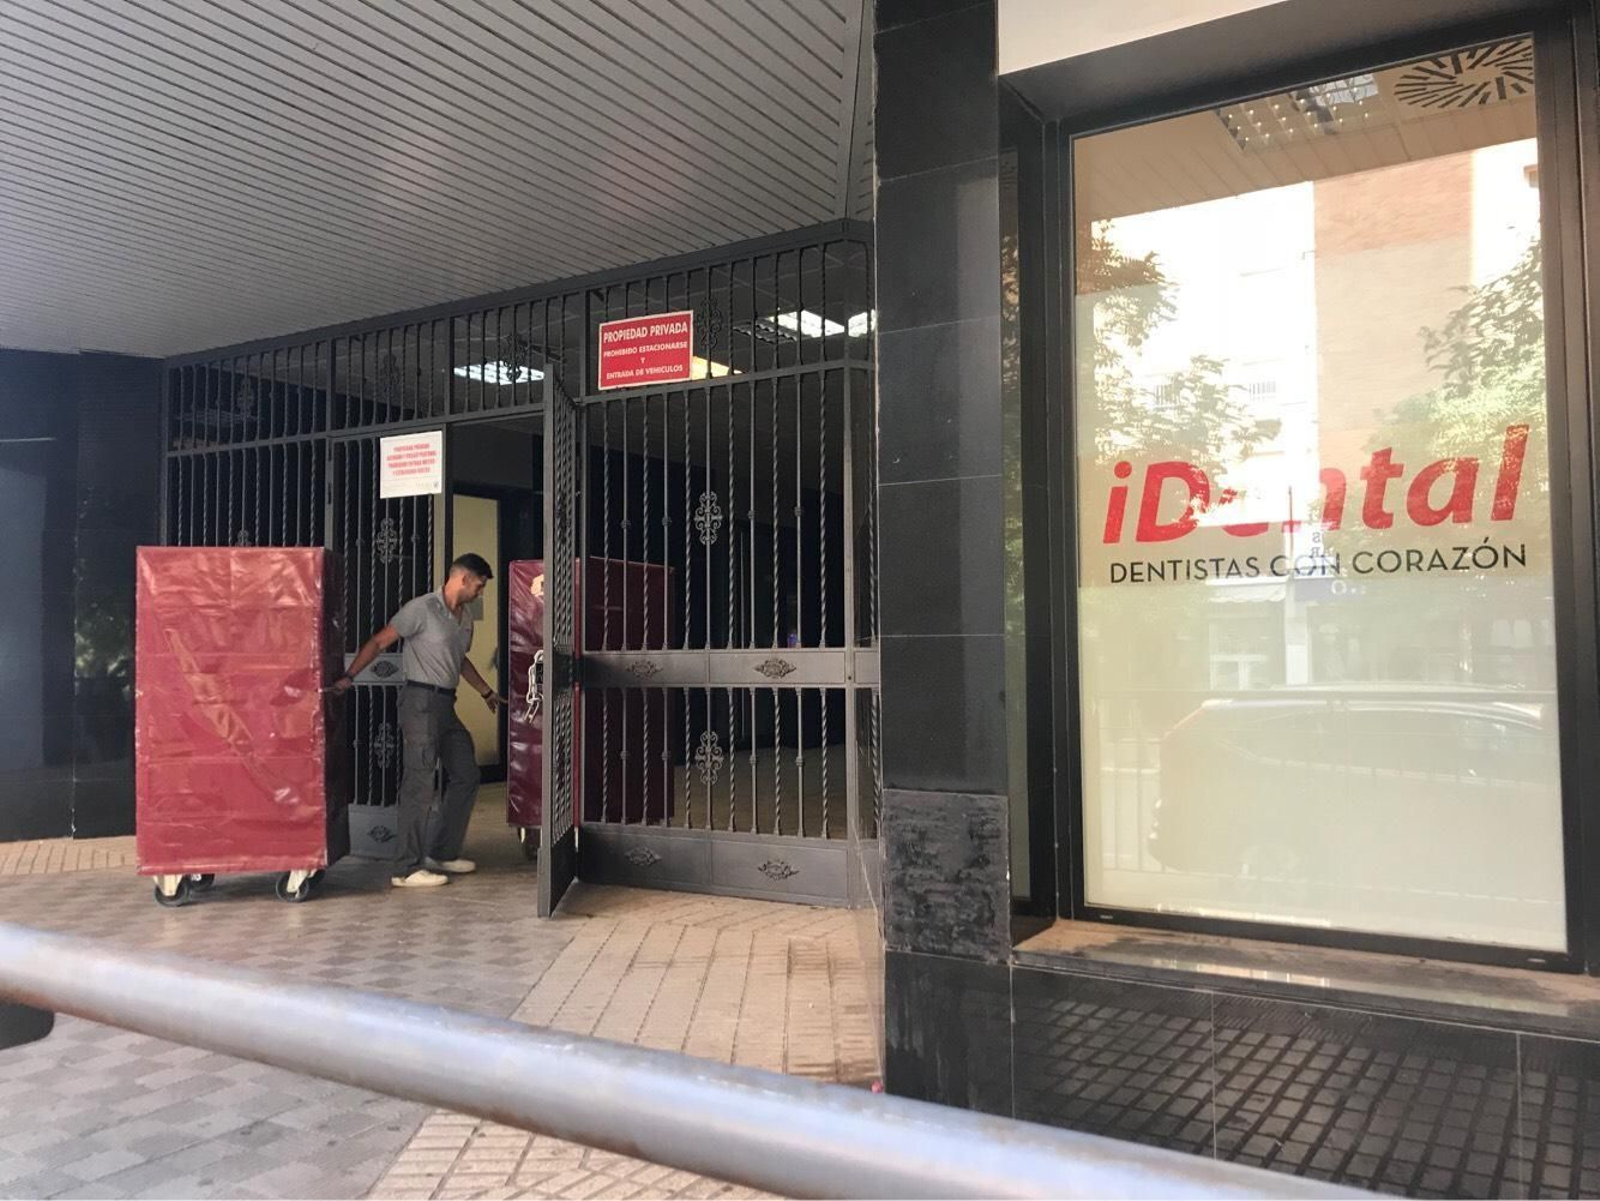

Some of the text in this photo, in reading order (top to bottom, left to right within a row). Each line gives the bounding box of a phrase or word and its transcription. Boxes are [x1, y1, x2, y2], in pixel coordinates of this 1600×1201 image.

[604, 321, 688, 343] PROPIEDAD PRIVADA
[603, 341, 687, 357] PROHIBIDO ESTACIONARSE
[606, 364, 683, 379] ENTRADA DE VEHICULOS
[1110, 556, 1261, 583] DENTISTAS
[1269, 553, 1341, 577] CON
[1352, 536, 1526, 574] CORAZÓN
